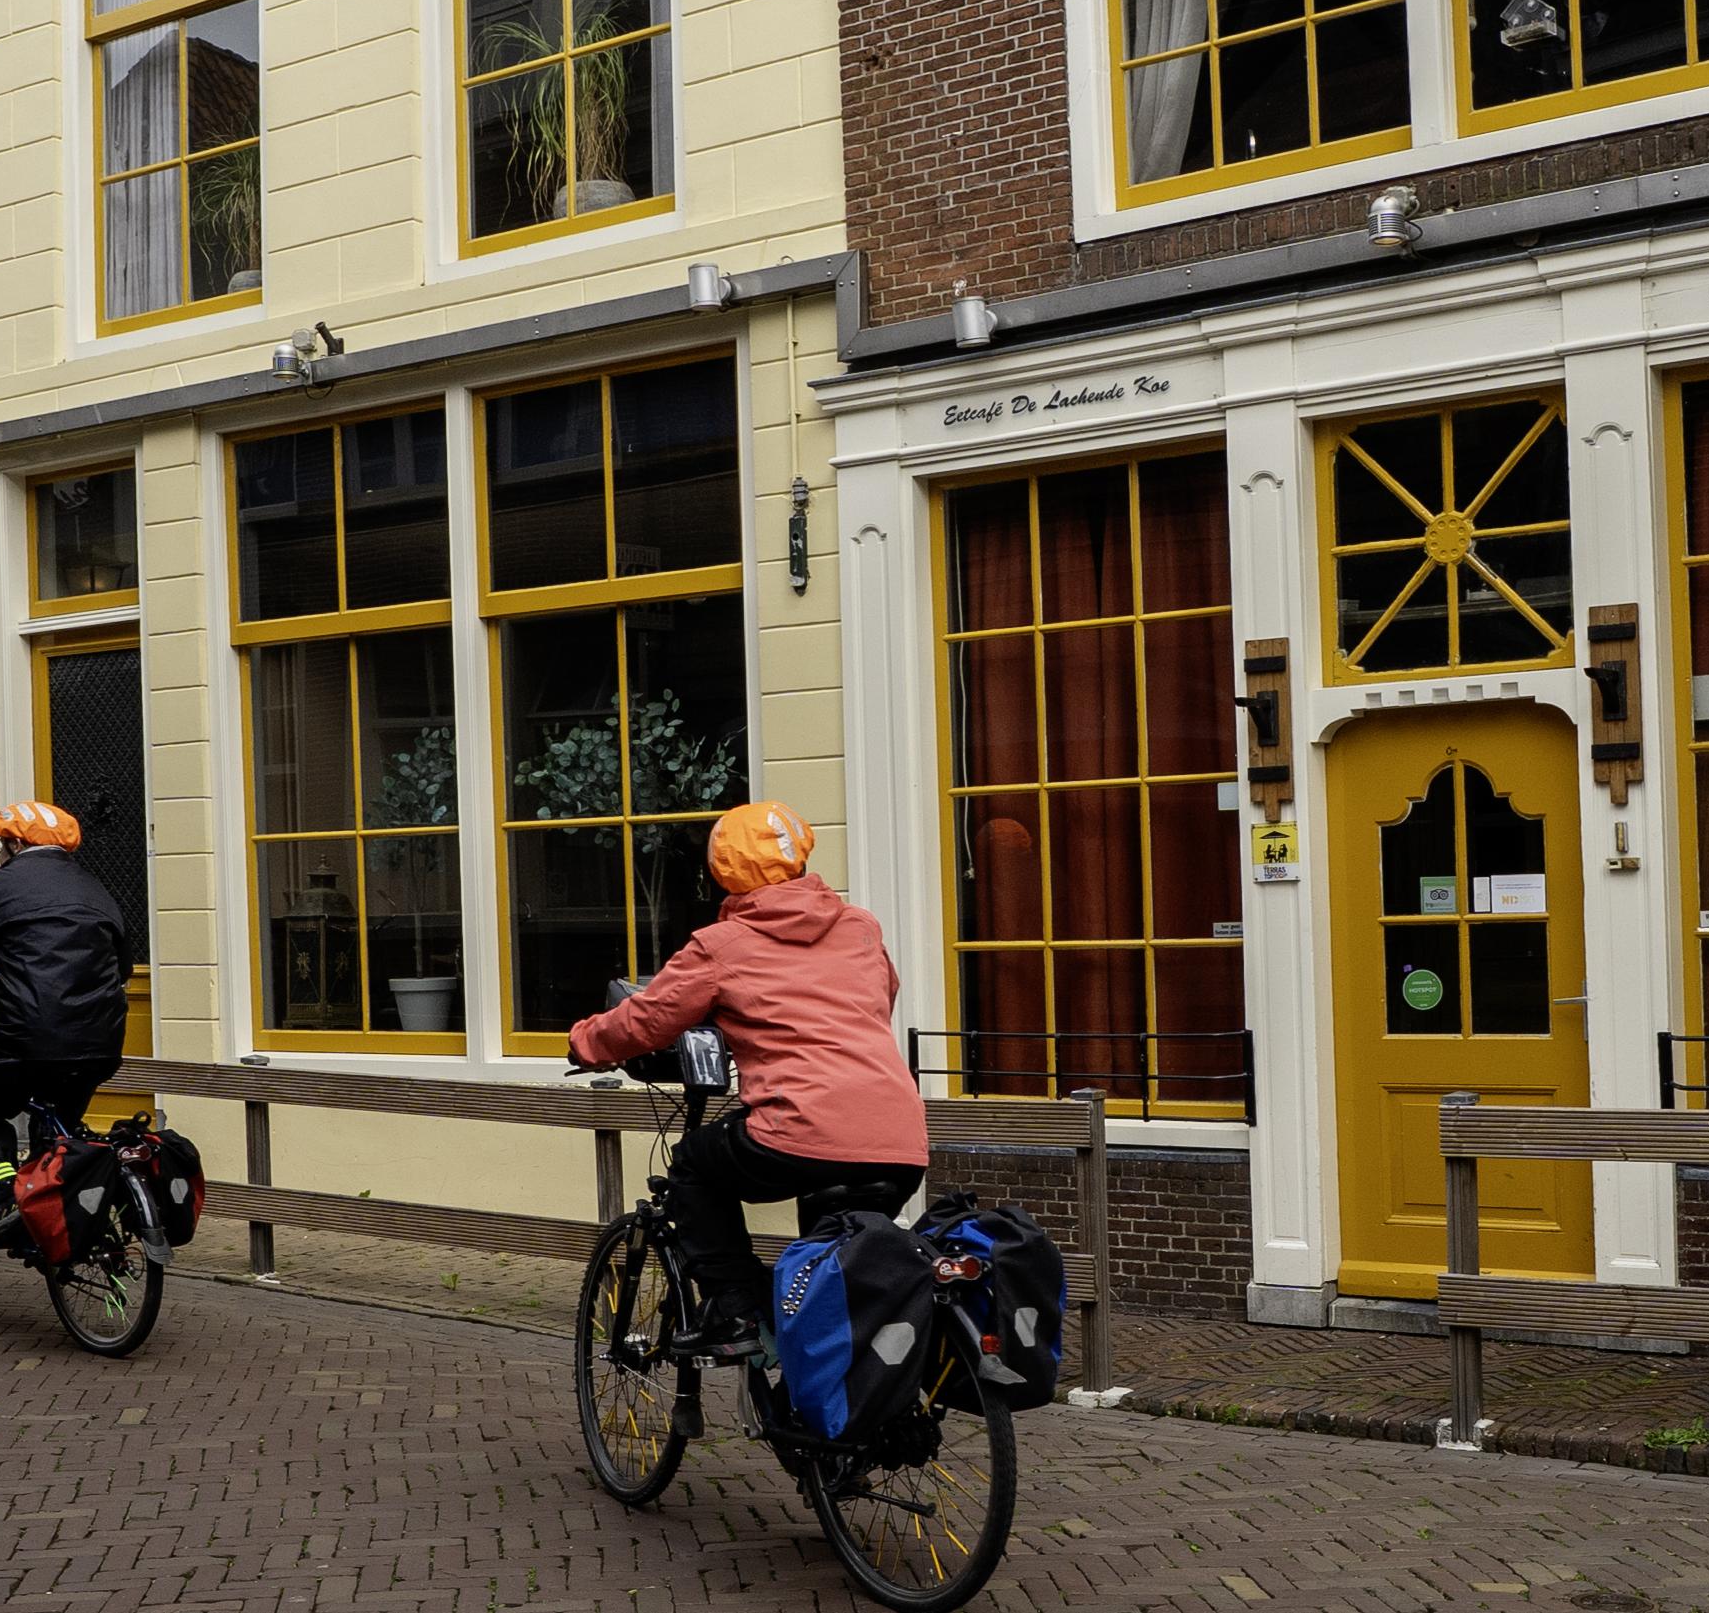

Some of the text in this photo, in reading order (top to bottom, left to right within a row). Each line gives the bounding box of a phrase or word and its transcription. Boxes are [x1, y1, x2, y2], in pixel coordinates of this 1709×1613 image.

[943, 376, 1170, 426] Eetcafé De Lachende Koe
